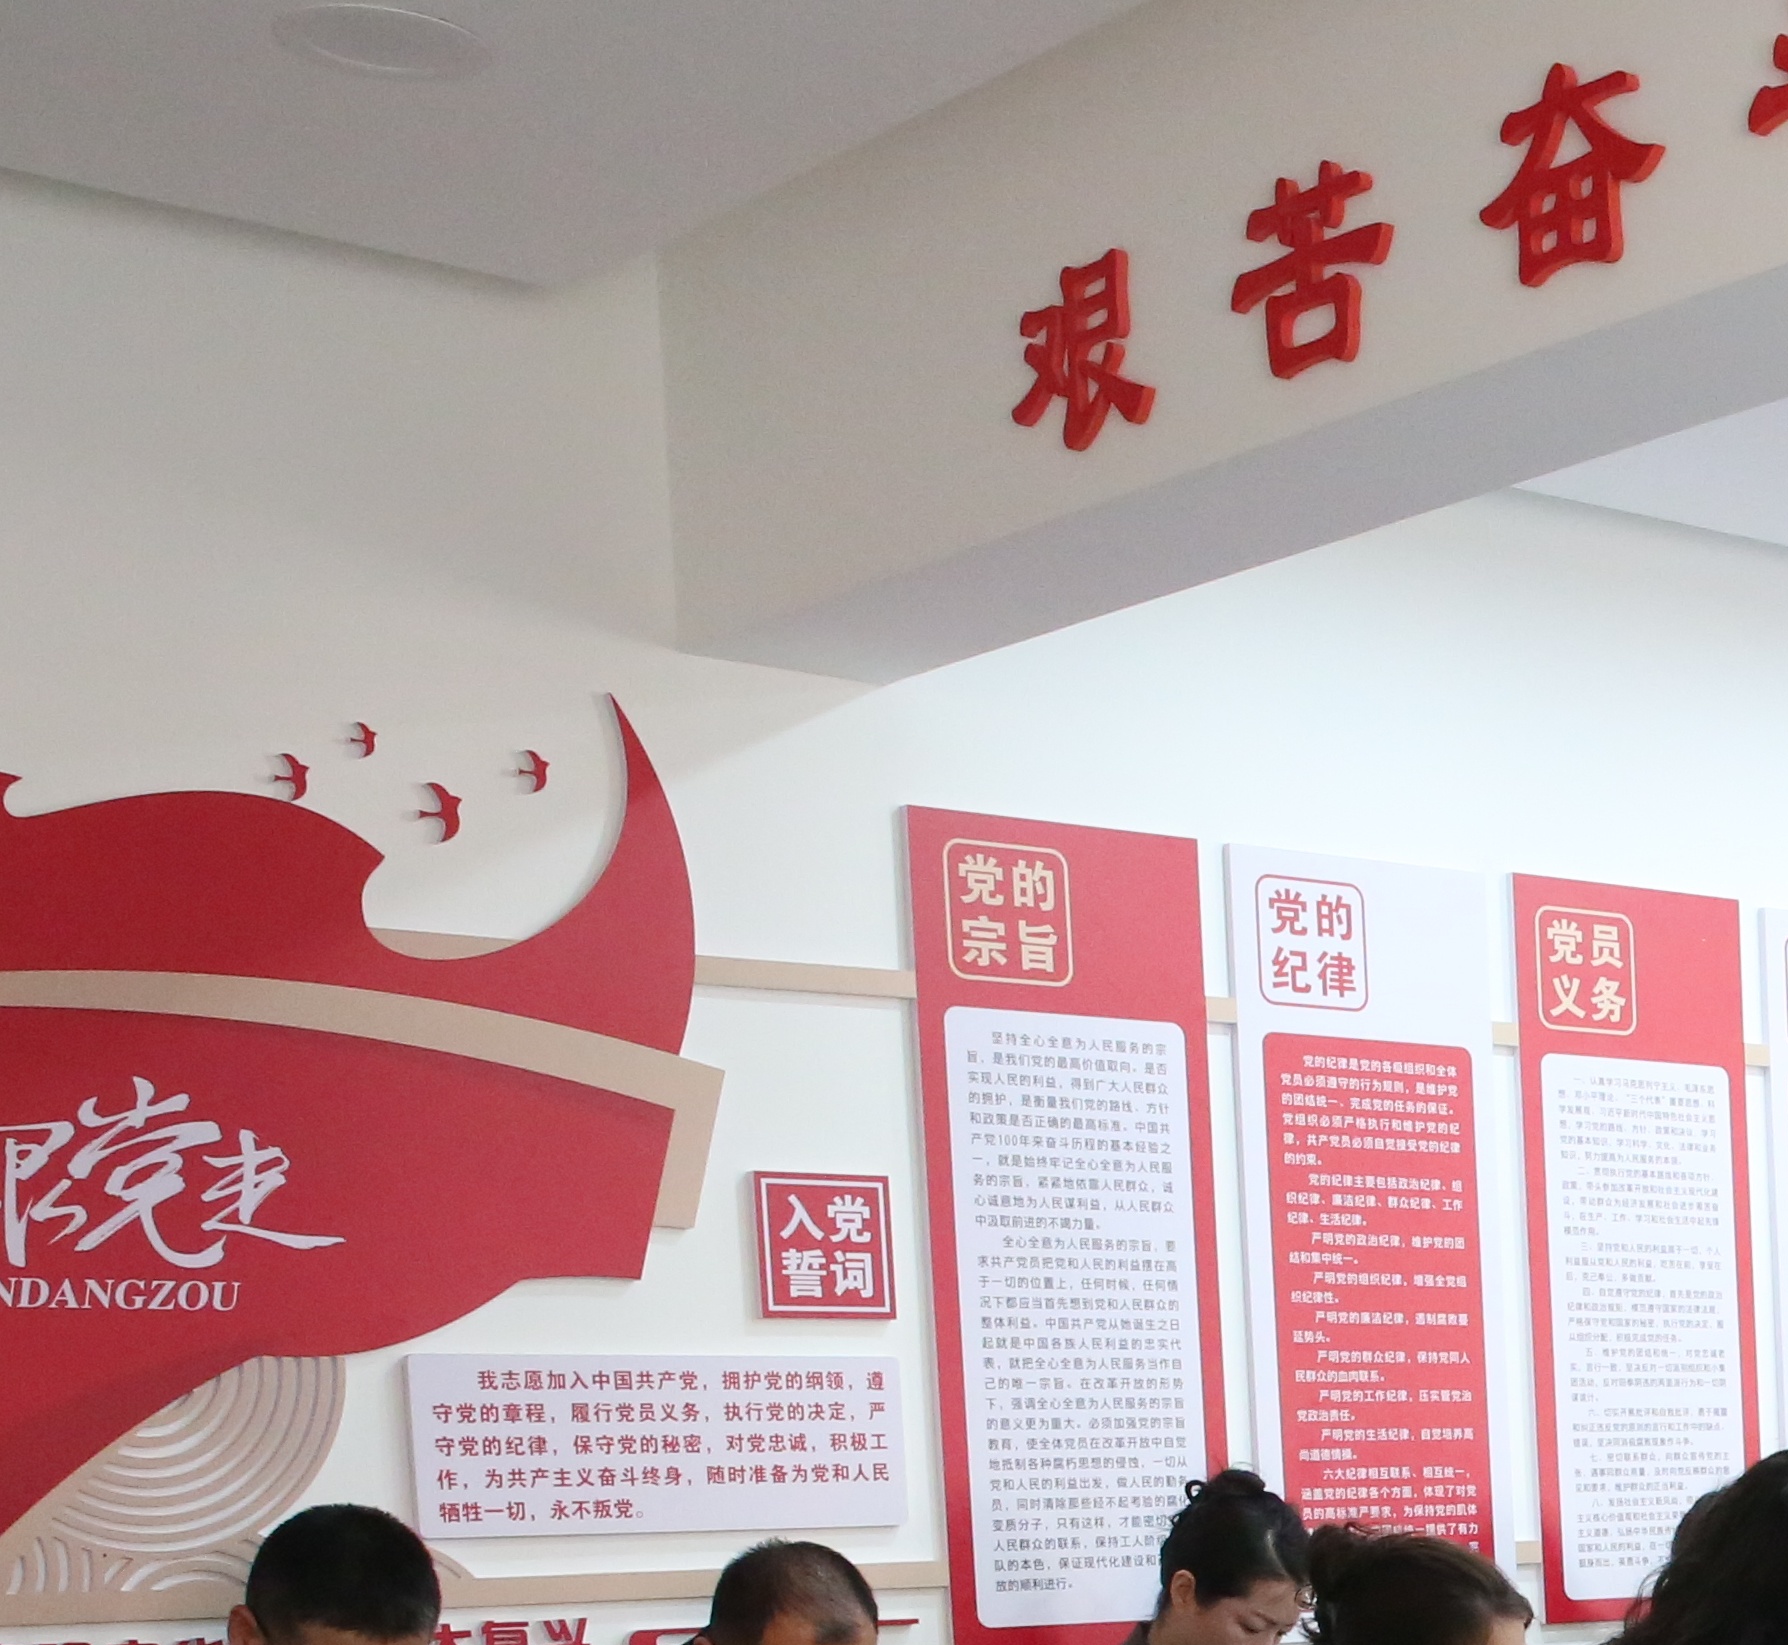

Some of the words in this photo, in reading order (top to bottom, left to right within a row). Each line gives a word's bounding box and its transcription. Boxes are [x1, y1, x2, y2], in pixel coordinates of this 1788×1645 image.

[957, 853, 1055, 911] 党的
[1269, 888, 1352, 940] 党的
[962, 915, 1058, 972] 宗旨
[1547, 918, 1624, 969] 党员
[1271, 946, 1356, 998] 纪律
[1550, 974, 1626, 1023] 义务
[779, 1193, 872, 1245] 入党
[781, 1248, 874, 1299] 誓词
[477, 1370, 885, 1392] 我志愿加入中国共产党，拥护党的纲领，遵
[432, 1402, 886, 1425] 守党的章程，履行党员义务，执行党的决定，严
[435, 1433, 888, 1457] 守党的纪律，保守党的秘密，对党忠诚，积极工
[437, 1463, 890, 1490] 作，为共产主义奋斗终身，随时准备为党和人民
[439, 1499, 644, 1524] 牺牲一切，永不叛党。
